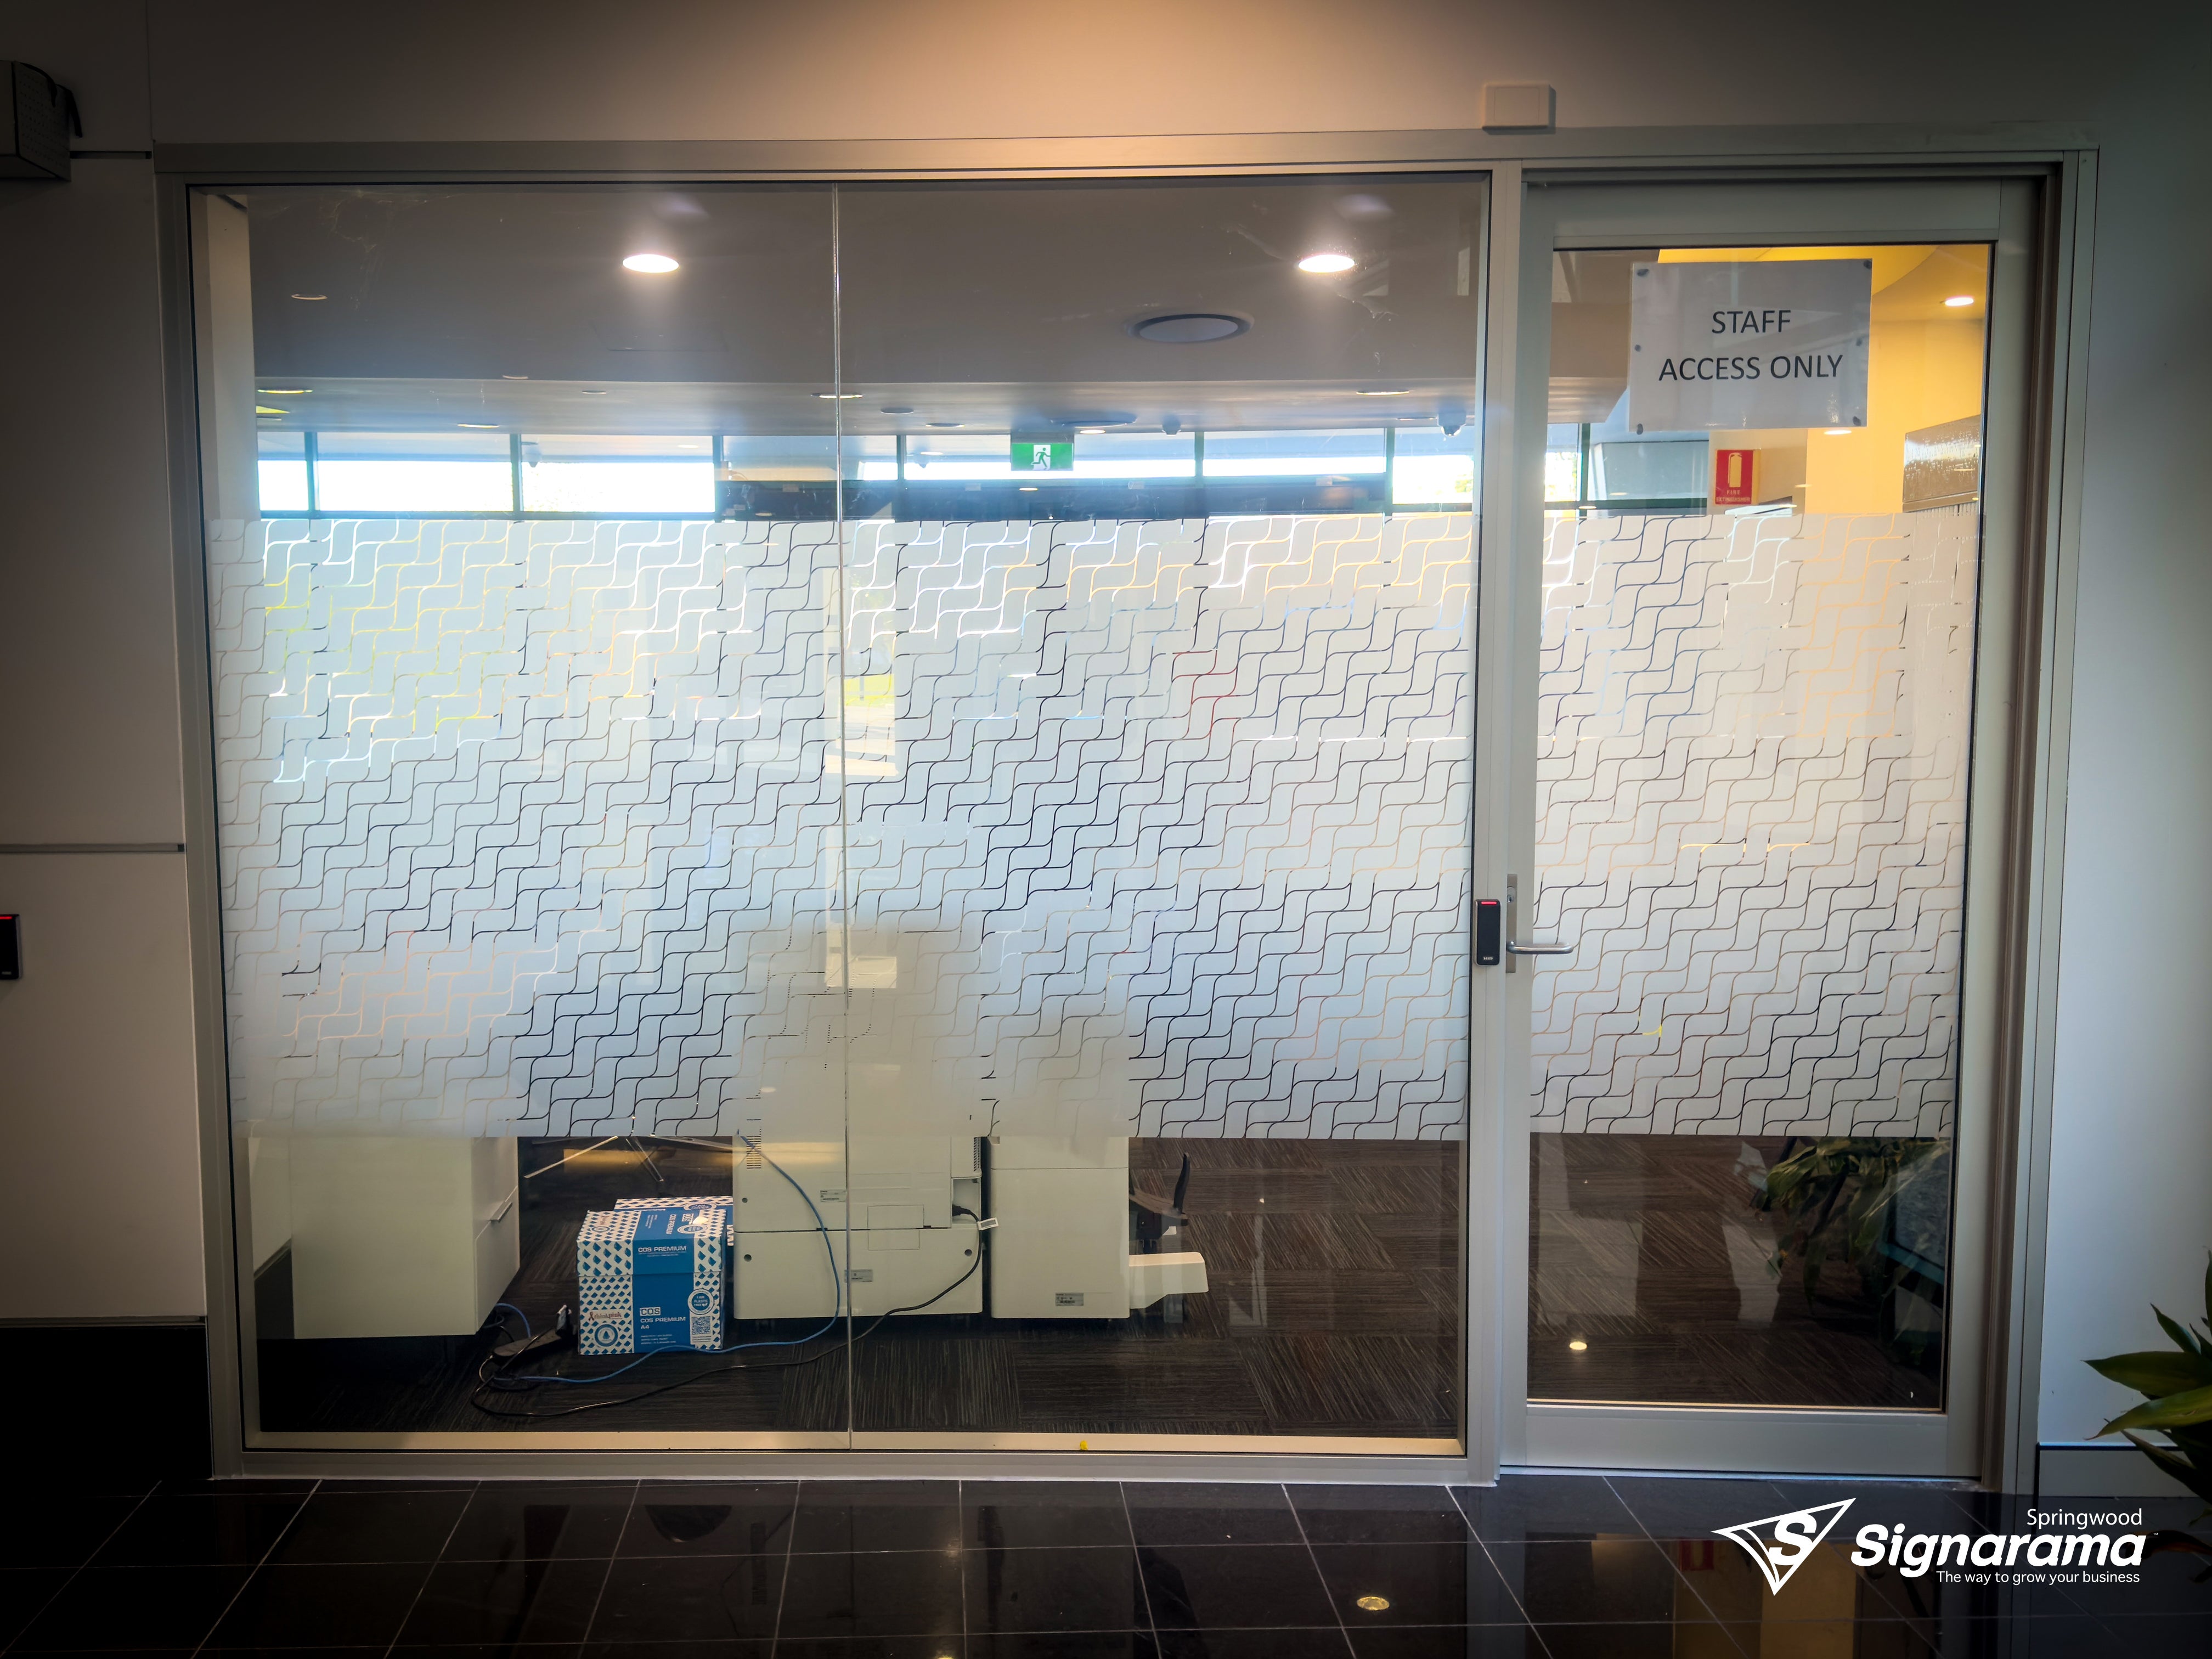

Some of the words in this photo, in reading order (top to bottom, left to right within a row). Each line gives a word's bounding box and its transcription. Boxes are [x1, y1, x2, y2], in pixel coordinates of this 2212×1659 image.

[1712, 309, 1791, 334] STAFF
[1658, 356, 1760, 381] ACCESS
[1770, 354, 1843, 379] ONLY
